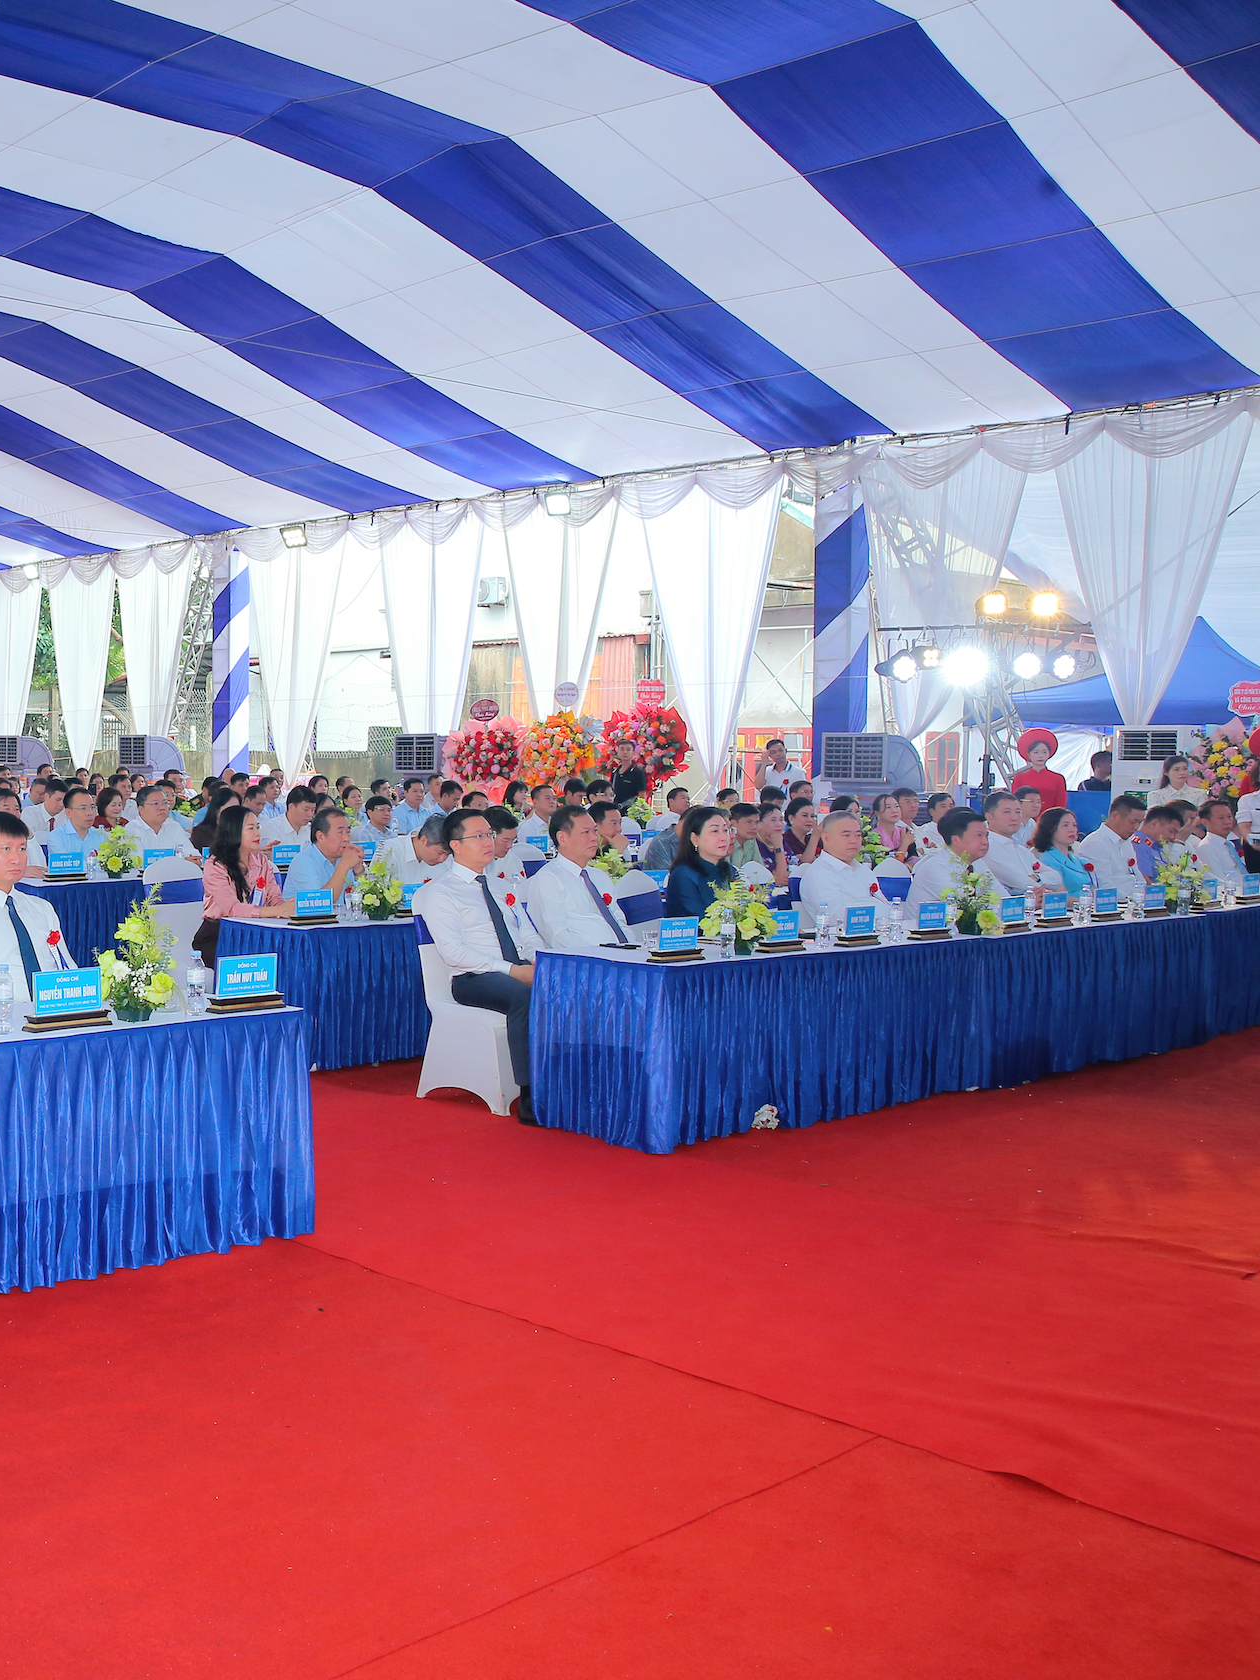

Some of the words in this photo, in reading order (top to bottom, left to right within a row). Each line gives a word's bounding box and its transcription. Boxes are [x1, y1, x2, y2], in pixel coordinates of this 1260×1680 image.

[56, 975, 70, 983] ĐỒNG
[242, 972, 253, 983] HUY
[253, 968, 268, 982] TUẤN
[39, 985, 62, 1001] NGUYỄN
[63, 986, 82, 999] THANH
[82, 984, 97, 997] BÌNH
